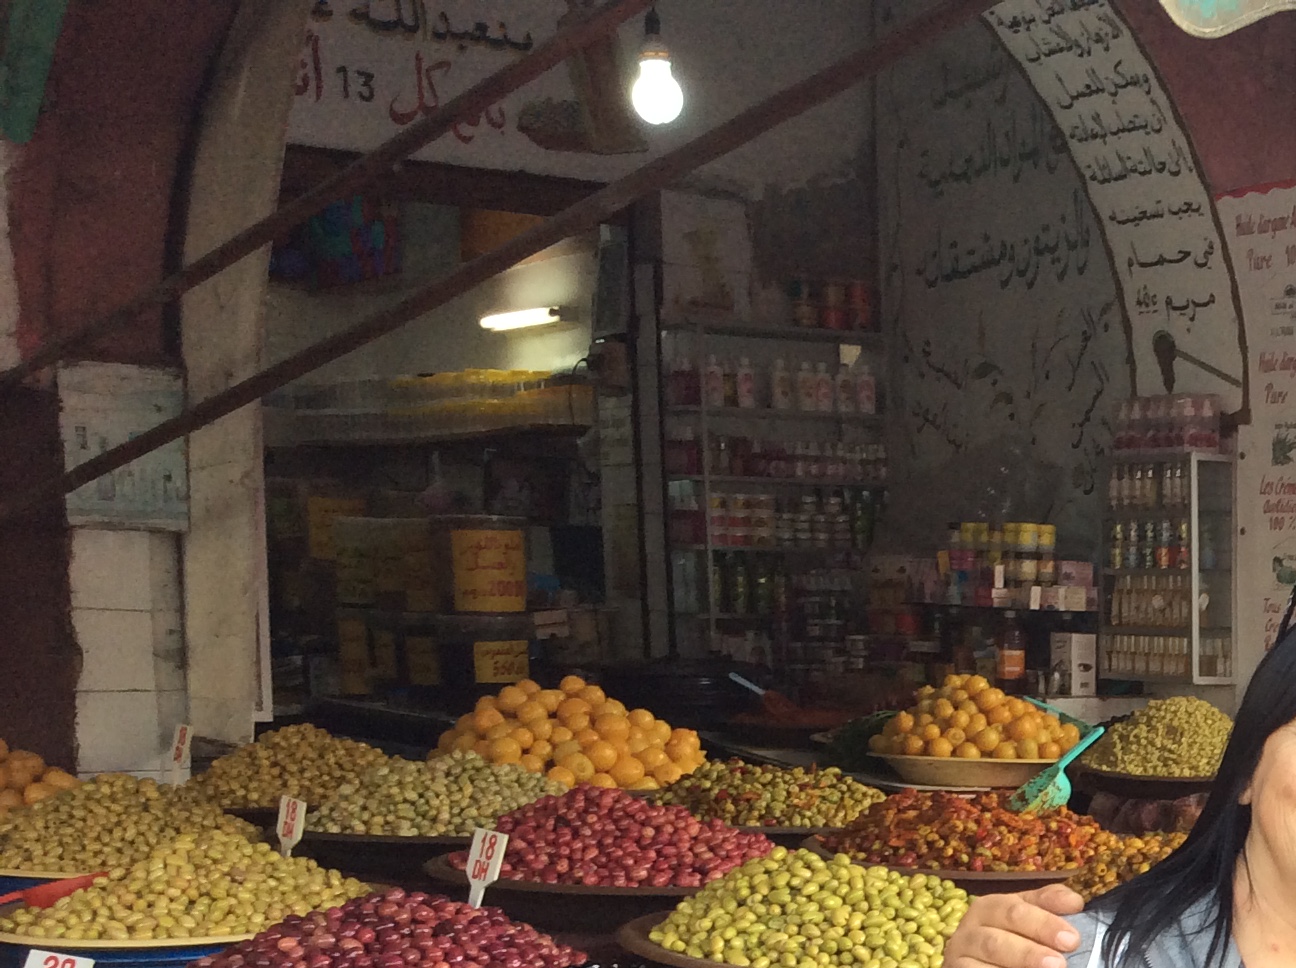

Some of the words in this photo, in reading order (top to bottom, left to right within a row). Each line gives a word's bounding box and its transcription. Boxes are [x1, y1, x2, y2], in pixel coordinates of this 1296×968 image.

[335, 64, 376, 103] 13
[1127, 240, 1192, 279] حمام
[1194, 236, 1215, 270] في
[1164, 292, 1216, 334] مريم
[1259, 474, 1274, 496] Les
[478, 831, 498, 861] 18
[471, 859, 490, 882] DH
